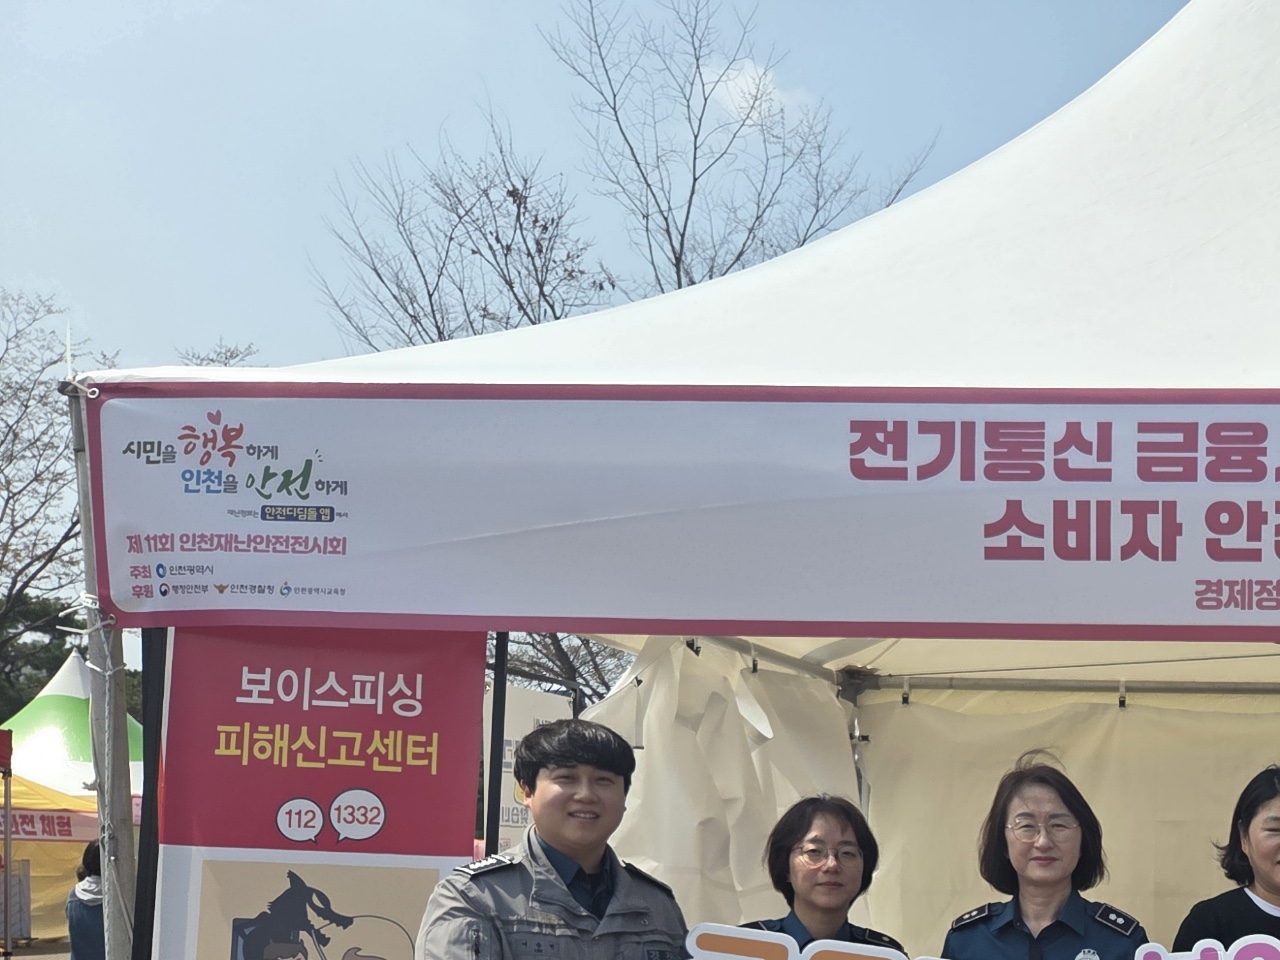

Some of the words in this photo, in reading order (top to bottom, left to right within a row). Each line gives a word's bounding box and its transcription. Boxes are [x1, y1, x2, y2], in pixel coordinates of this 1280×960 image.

[122, 440, 177, 465] 시민을
[848, 419, 1113, 482] 전기통신
[180, 468, 239, 494] 인천을
[264, 506, 318, 521] 안전디딤돌
[983, 499, 1183, 563] 소비자
[179, 533, 347, 556] 인천재난안전전시회
[129, 564, 153, 580] 주최
[168, 564, 214, 576] 인천광역시
[131, 583, 155, 599] 후원
[171, 583, 209, 595] 행정안전부
[229, 583, 275, 595] 인천경찰청
[293, 586, 346, 596] 인천광역시교육청
[235, 665, 424, 718] 보이스피싱
[213, 721, 440, 775] 피해신고센터
[39, 814, 73, 837] 체험
[284, 808, 316, 830] 112
[333, 803, 381, 826] 1332
